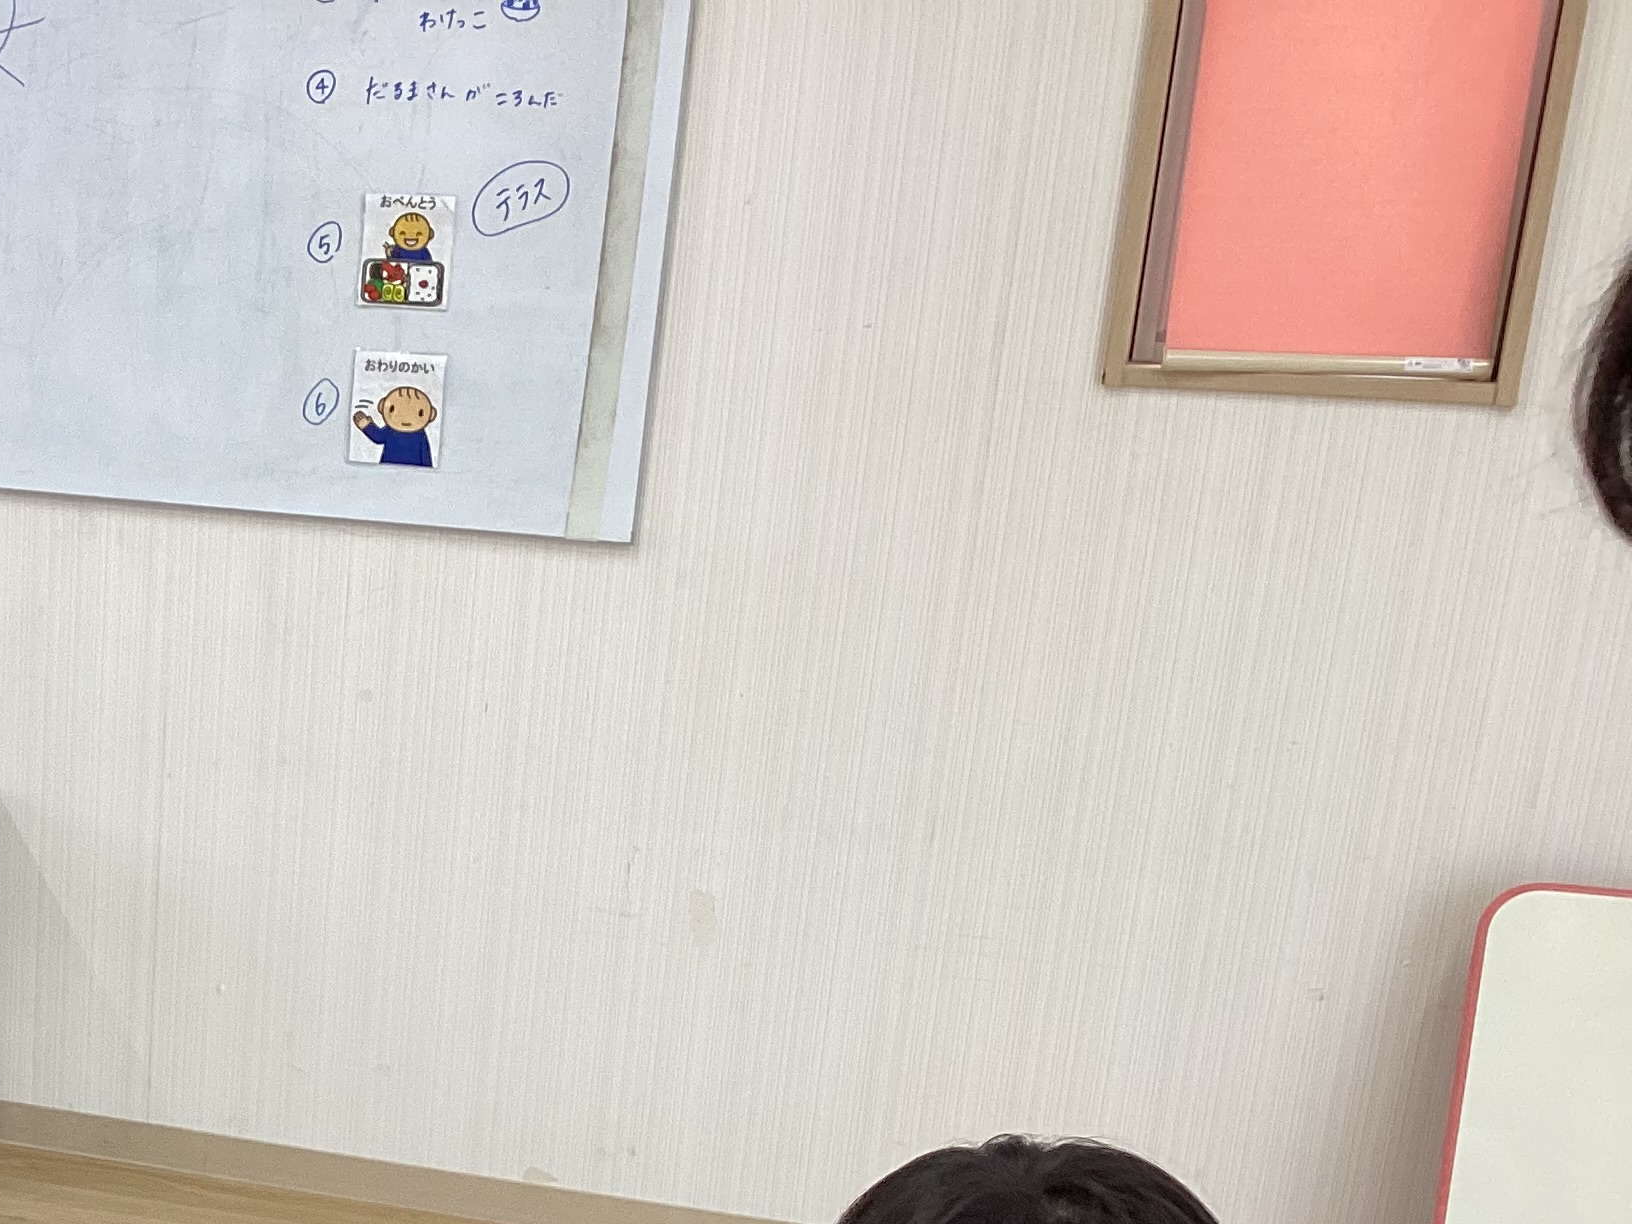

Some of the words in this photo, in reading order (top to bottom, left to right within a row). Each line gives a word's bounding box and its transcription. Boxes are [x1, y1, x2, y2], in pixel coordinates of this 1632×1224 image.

[495, 177, 552, 222] テラス
[364, 358, 435, 374] おわりのかい
